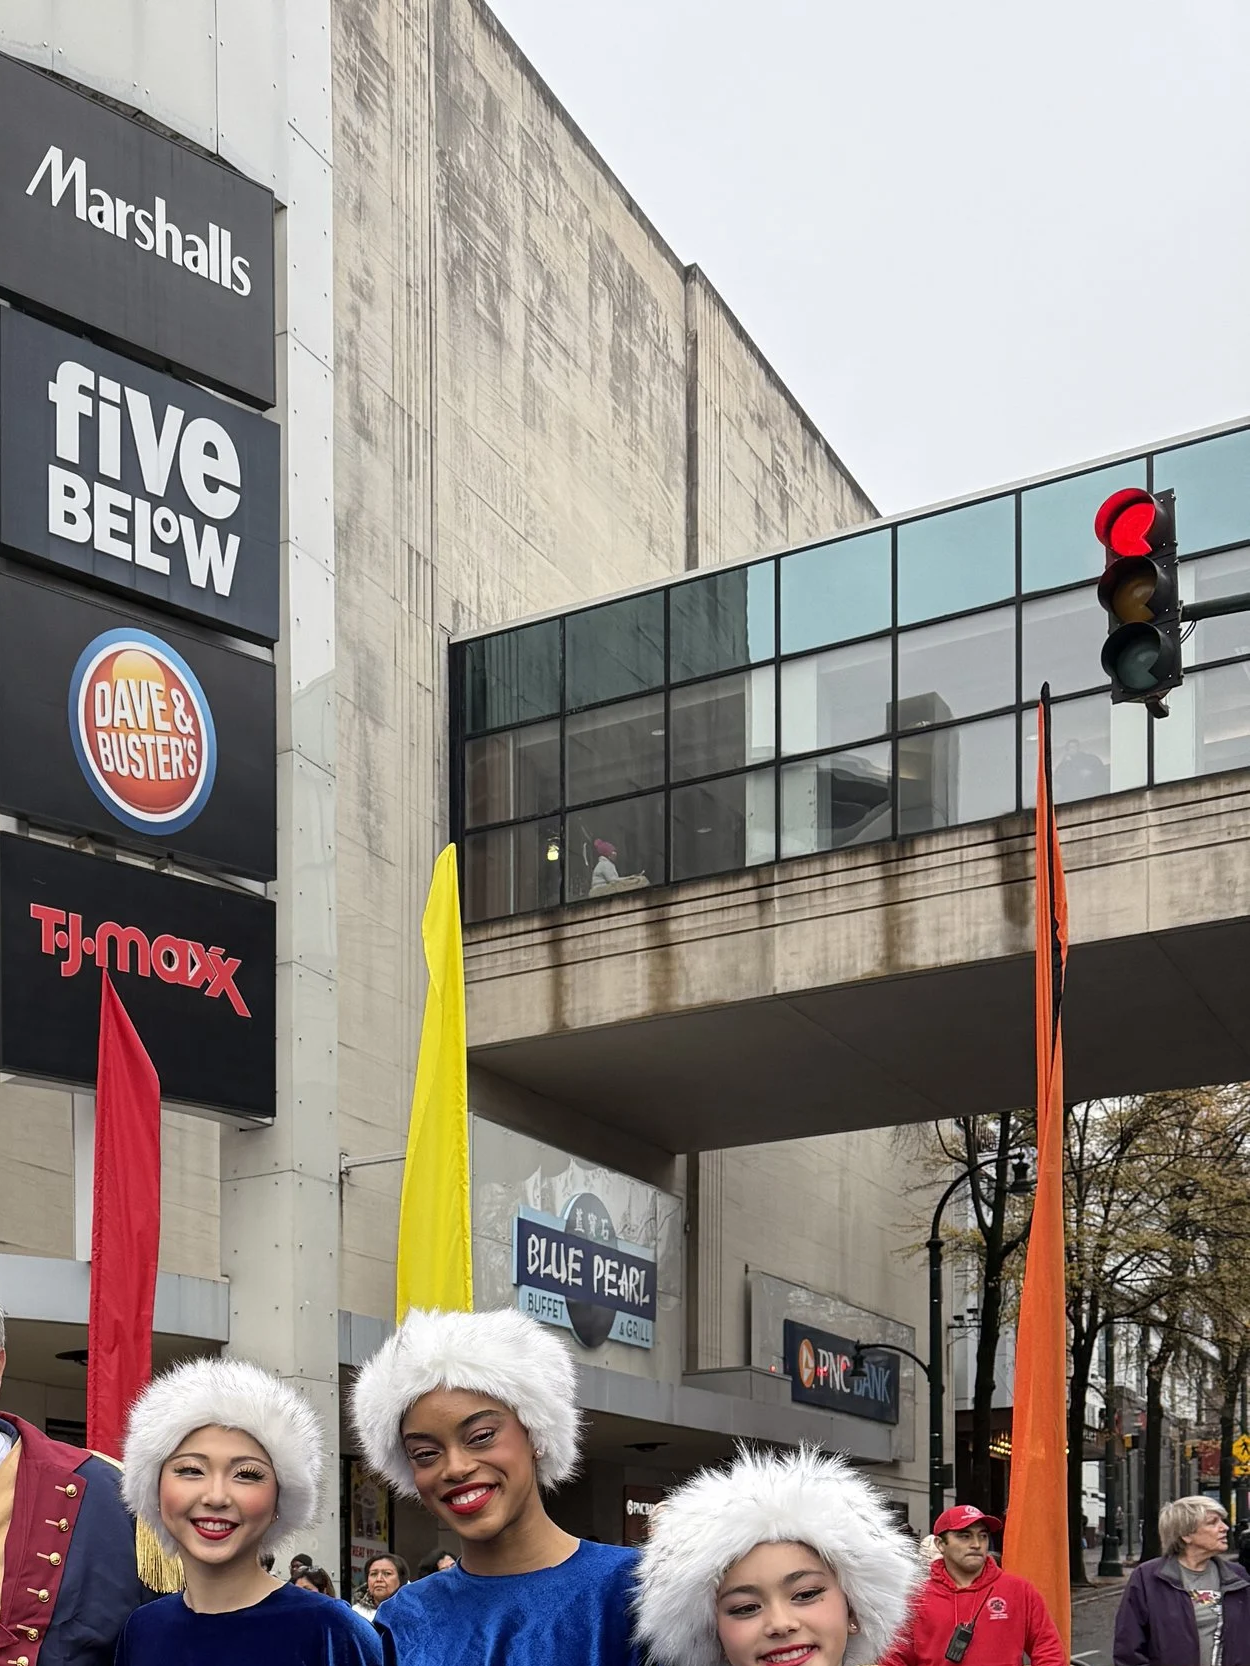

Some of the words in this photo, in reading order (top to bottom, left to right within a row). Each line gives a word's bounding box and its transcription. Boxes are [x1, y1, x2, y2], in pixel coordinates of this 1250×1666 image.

[25, 145, 252, 297] Marshalls
[94, 678, 172, 733] DAVE
[170, 687, 195, 736] &
[96, 731, 197, 782] BUSTER'S
[527, 1233, 584, 1287] BLUE
[593, 1254, 650, 1306] PEARL
[527, 1292, 565, 1321] BUFFET
[626, 1319, 650, 1342] GRILL
[817, 1348, 851, 1393] PNC
